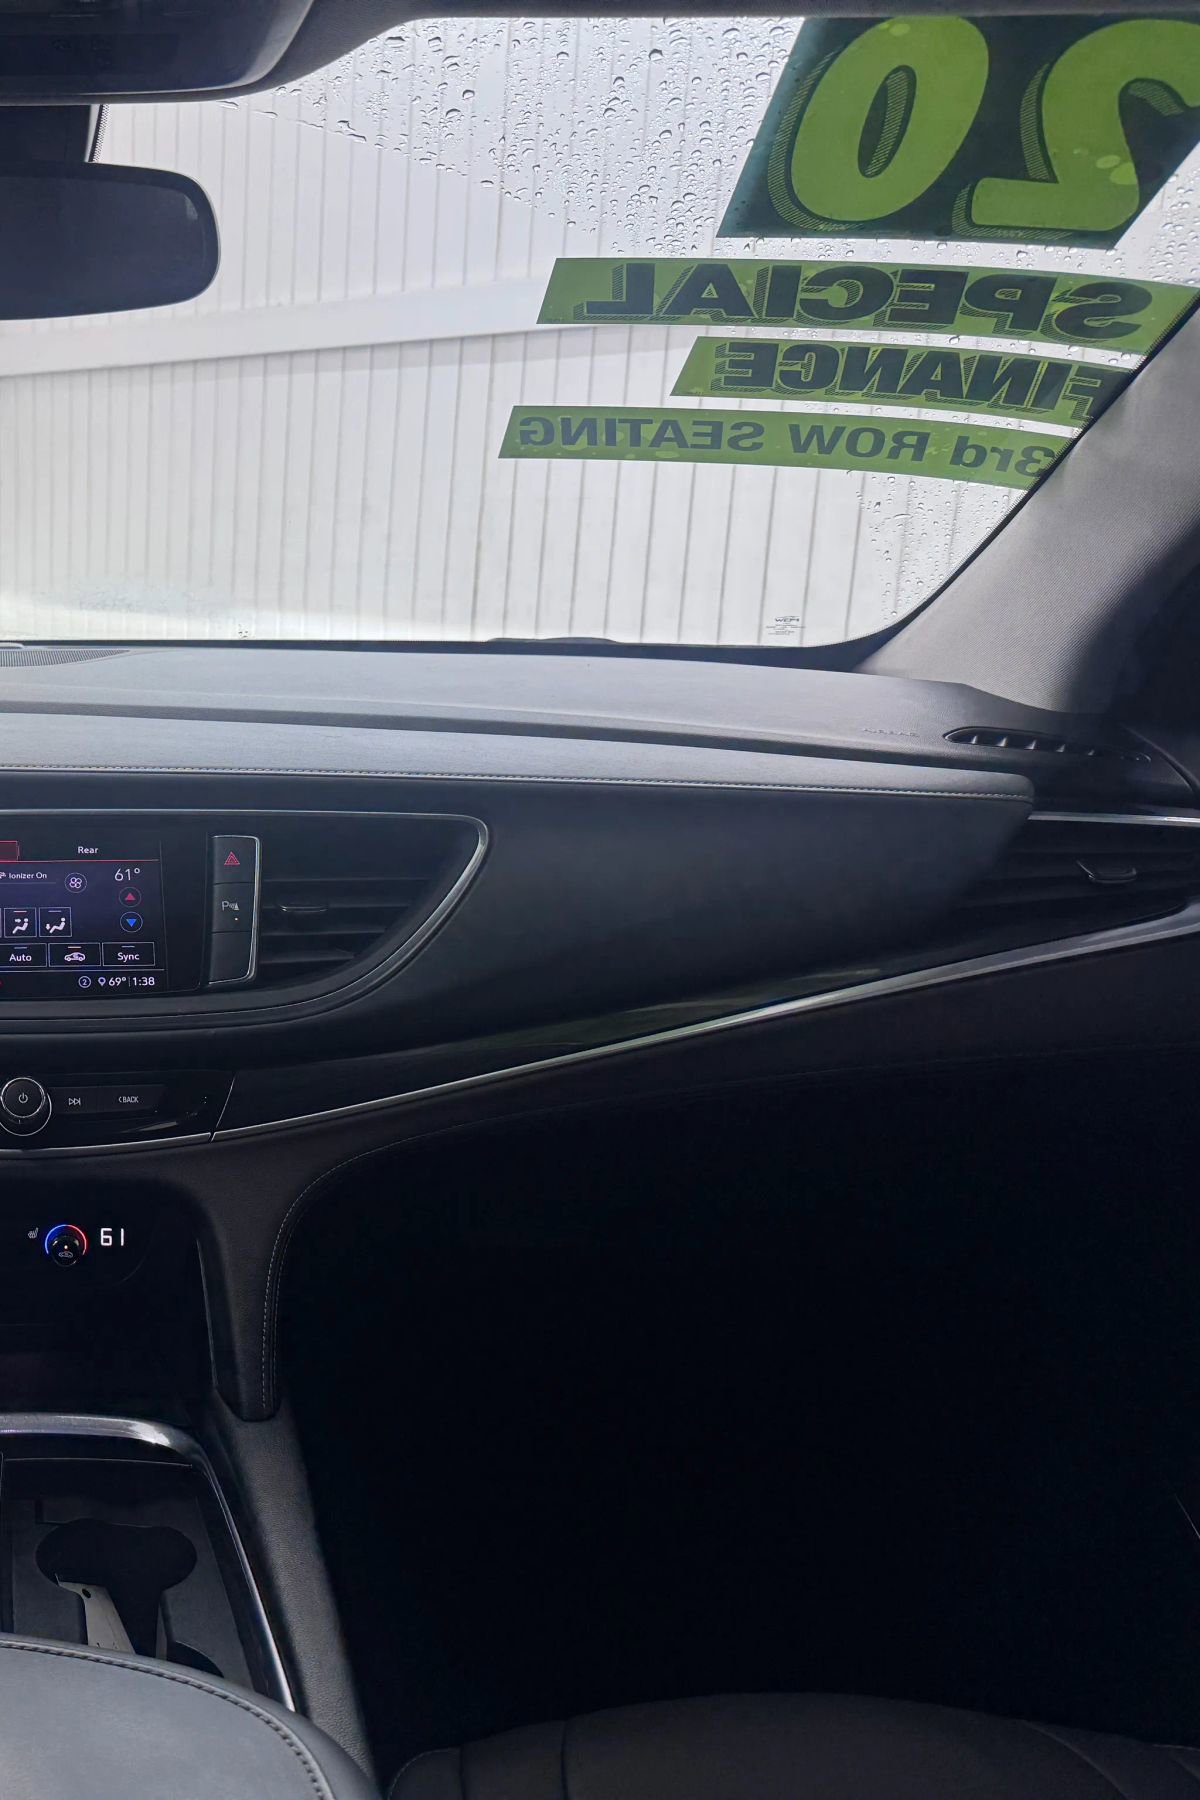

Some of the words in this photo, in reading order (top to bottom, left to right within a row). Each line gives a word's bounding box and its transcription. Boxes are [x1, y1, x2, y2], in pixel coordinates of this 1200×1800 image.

[77, 846, 99, 855] Rear
[8, 871, 35, 880] Ionizer
[36, 871, 48, 880] On
[114, 867, 141, 882] 61°
[9, 953, 32, 963] Auto
[117, 951, 140, 962] Sync
[108, 976, 127, 987] 69°
[132, 976, 155, 987] 1:38
[122, 1095, 139, 1104] BACK
[100, 1227, 125, 1247] 61
